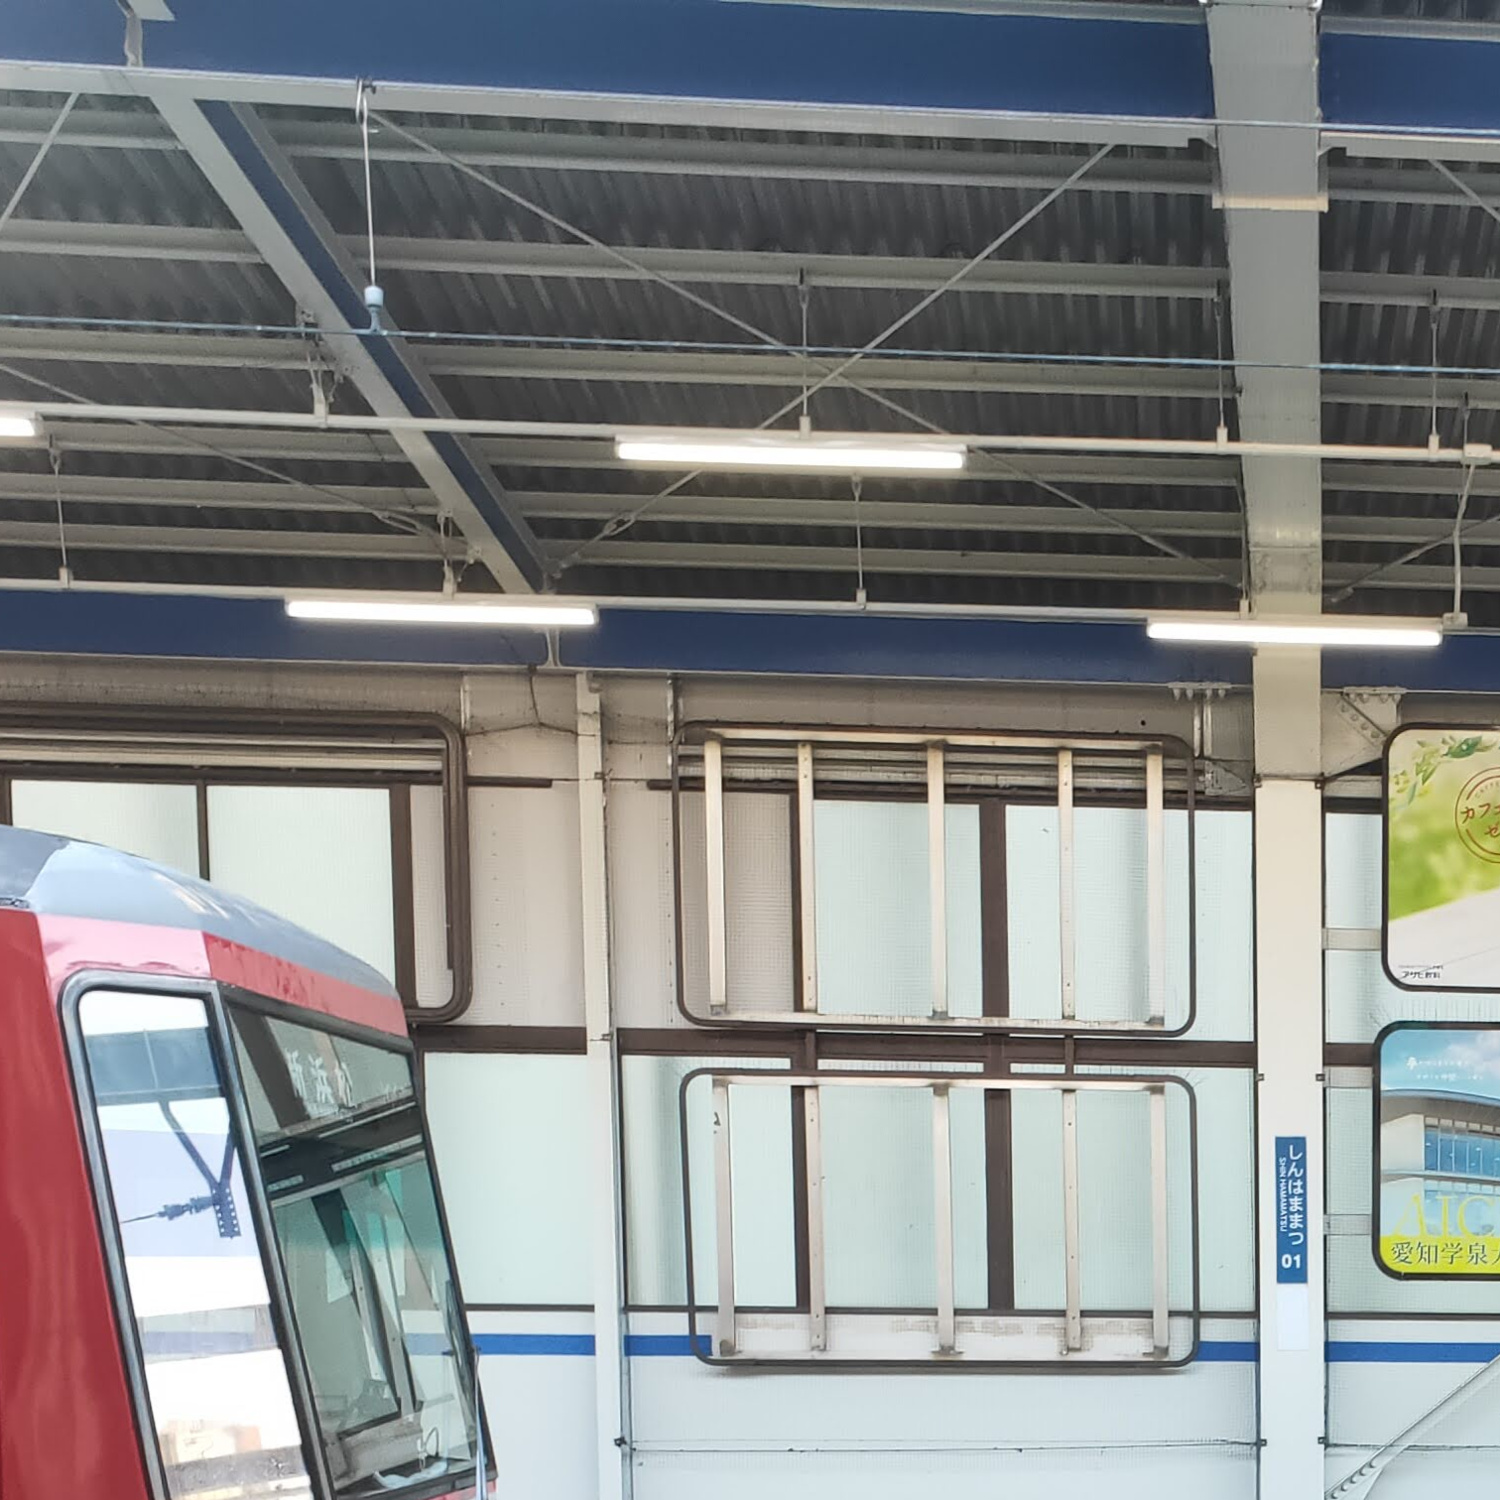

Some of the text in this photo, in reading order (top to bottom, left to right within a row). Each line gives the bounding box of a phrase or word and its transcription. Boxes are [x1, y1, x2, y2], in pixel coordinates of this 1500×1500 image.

[1288, 1145, 1304, 1246] しんはままつ
[1281, 1253, 1302, 1269] 01
